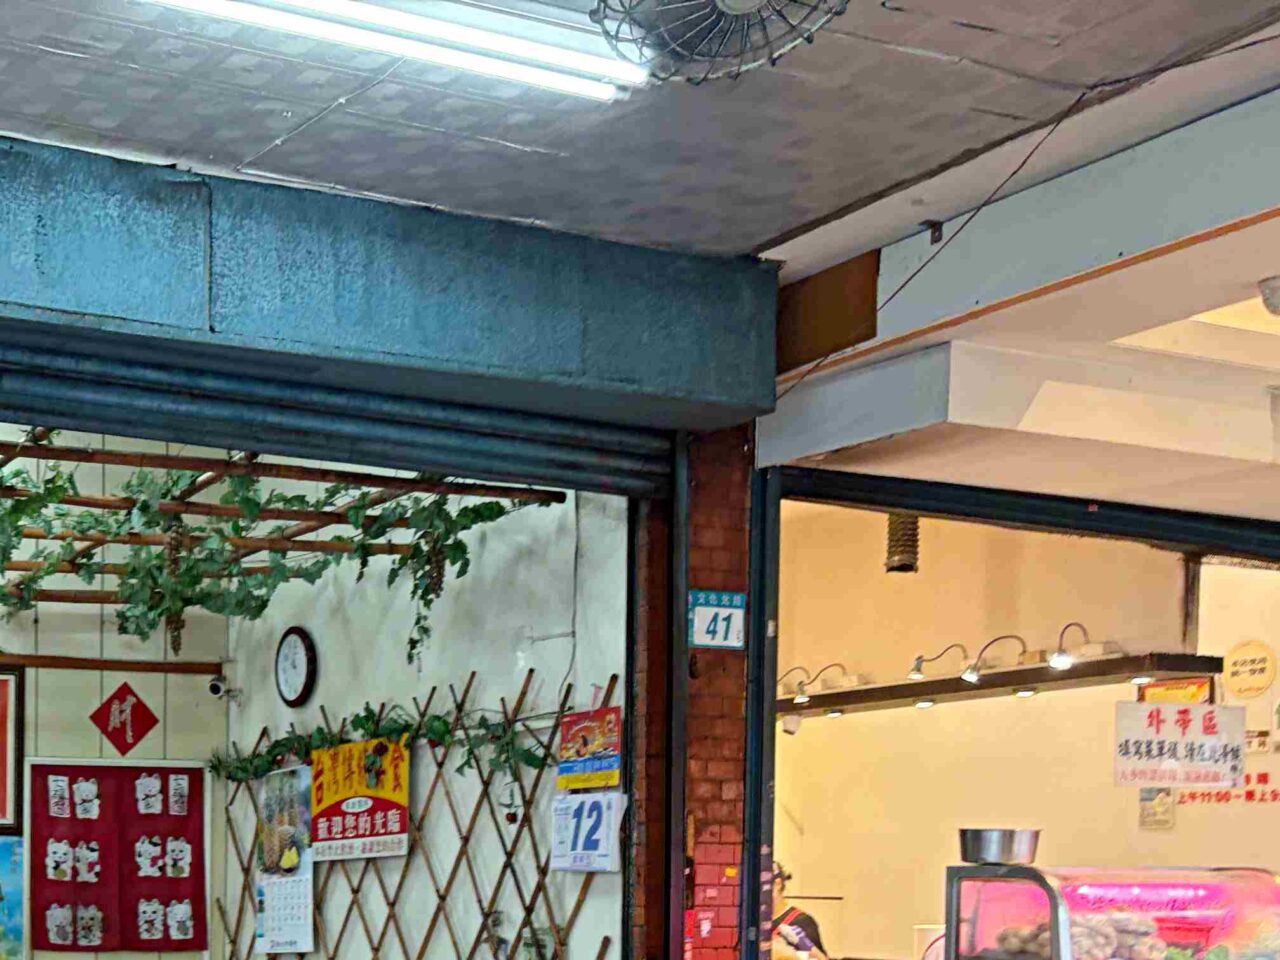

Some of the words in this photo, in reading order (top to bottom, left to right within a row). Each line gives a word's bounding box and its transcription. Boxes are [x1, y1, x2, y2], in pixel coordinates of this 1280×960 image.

[705, 612, 733, 641] 41
[317, 808, 401, 840] 歡迎您的光臨
[570, 800, 604, 852] 12
